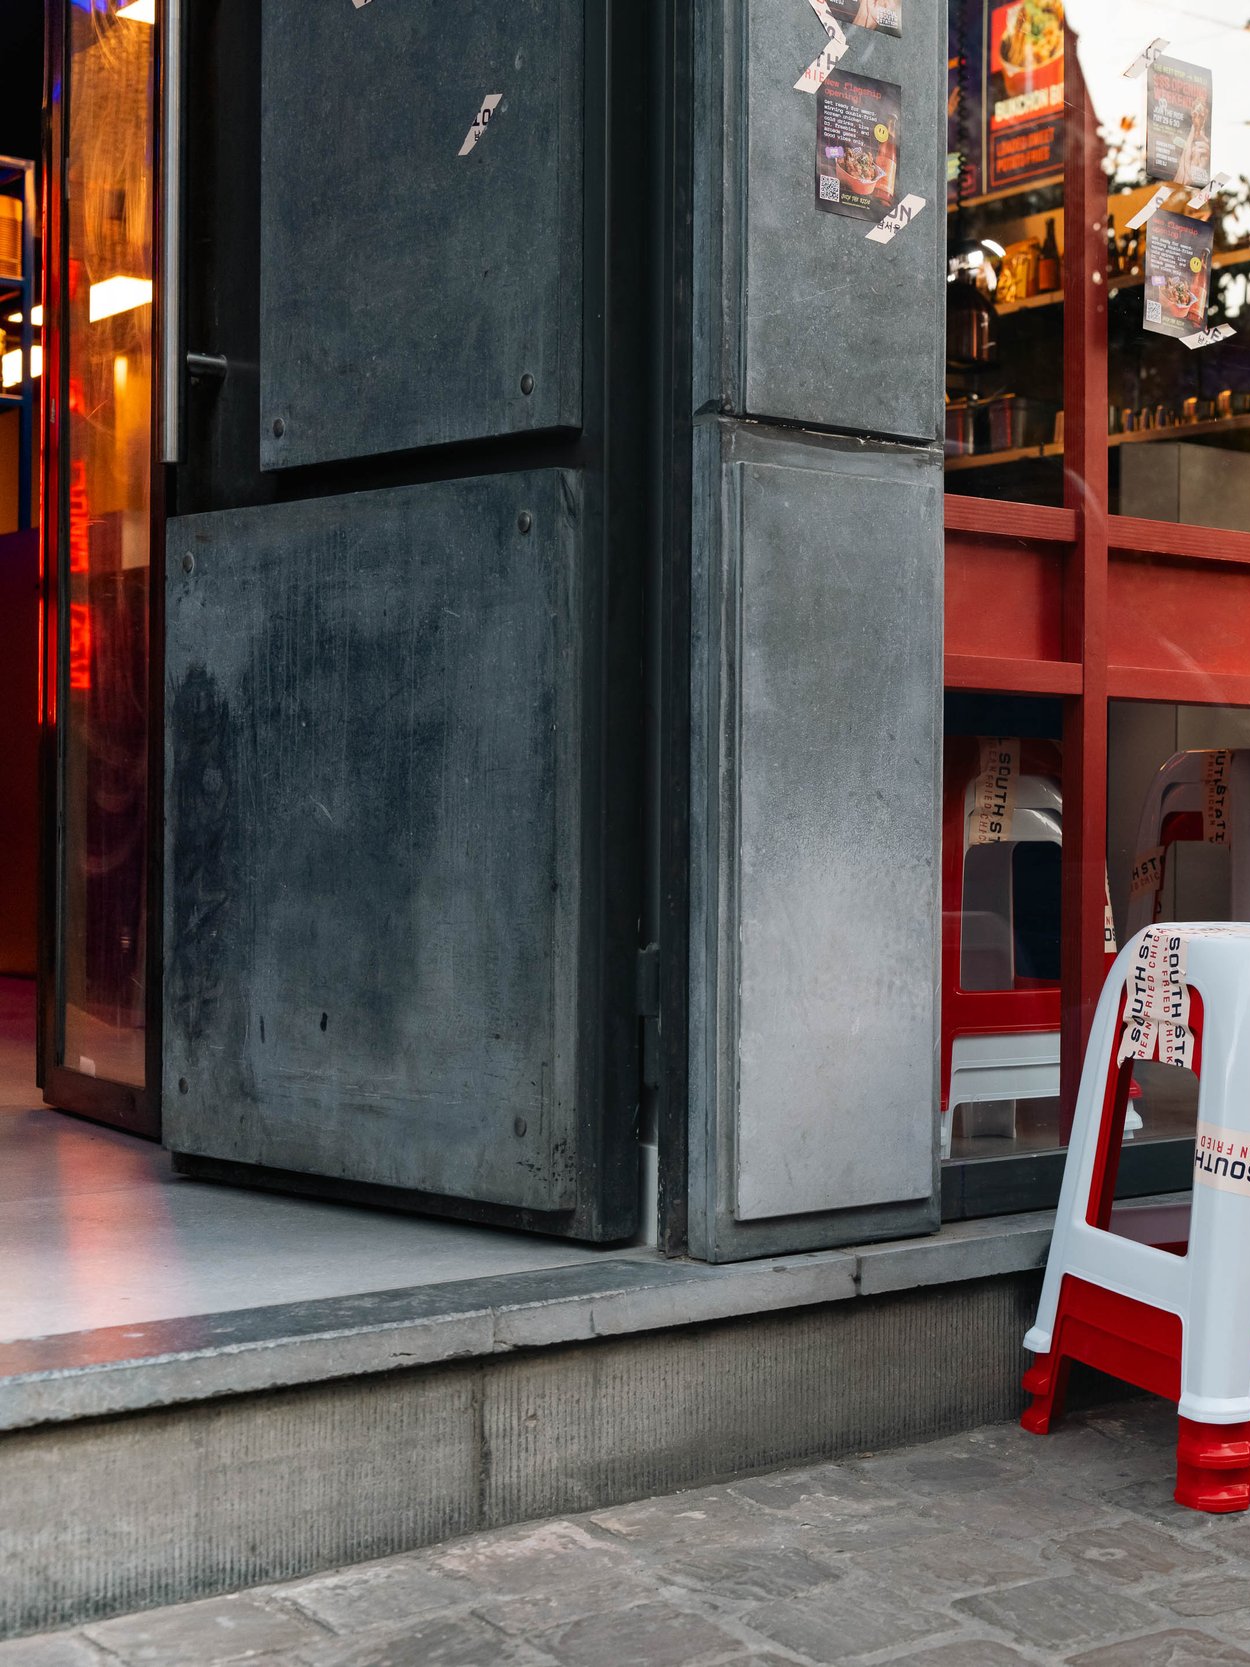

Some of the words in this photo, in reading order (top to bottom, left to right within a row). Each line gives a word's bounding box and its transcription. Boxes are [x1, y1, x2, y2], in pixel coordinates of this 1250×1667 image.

[993, 752, 1011, 817] SOUTH
[1131, 965, 1148, 1043] SOUTH
[1144, 975, 1155, 1019] FRIED
[1162, 969, 1170, 1013] FRIED
[1169, 936, 1183, 1018] SOUTH
[1200, 1135, 1234, 1156] FRIED
